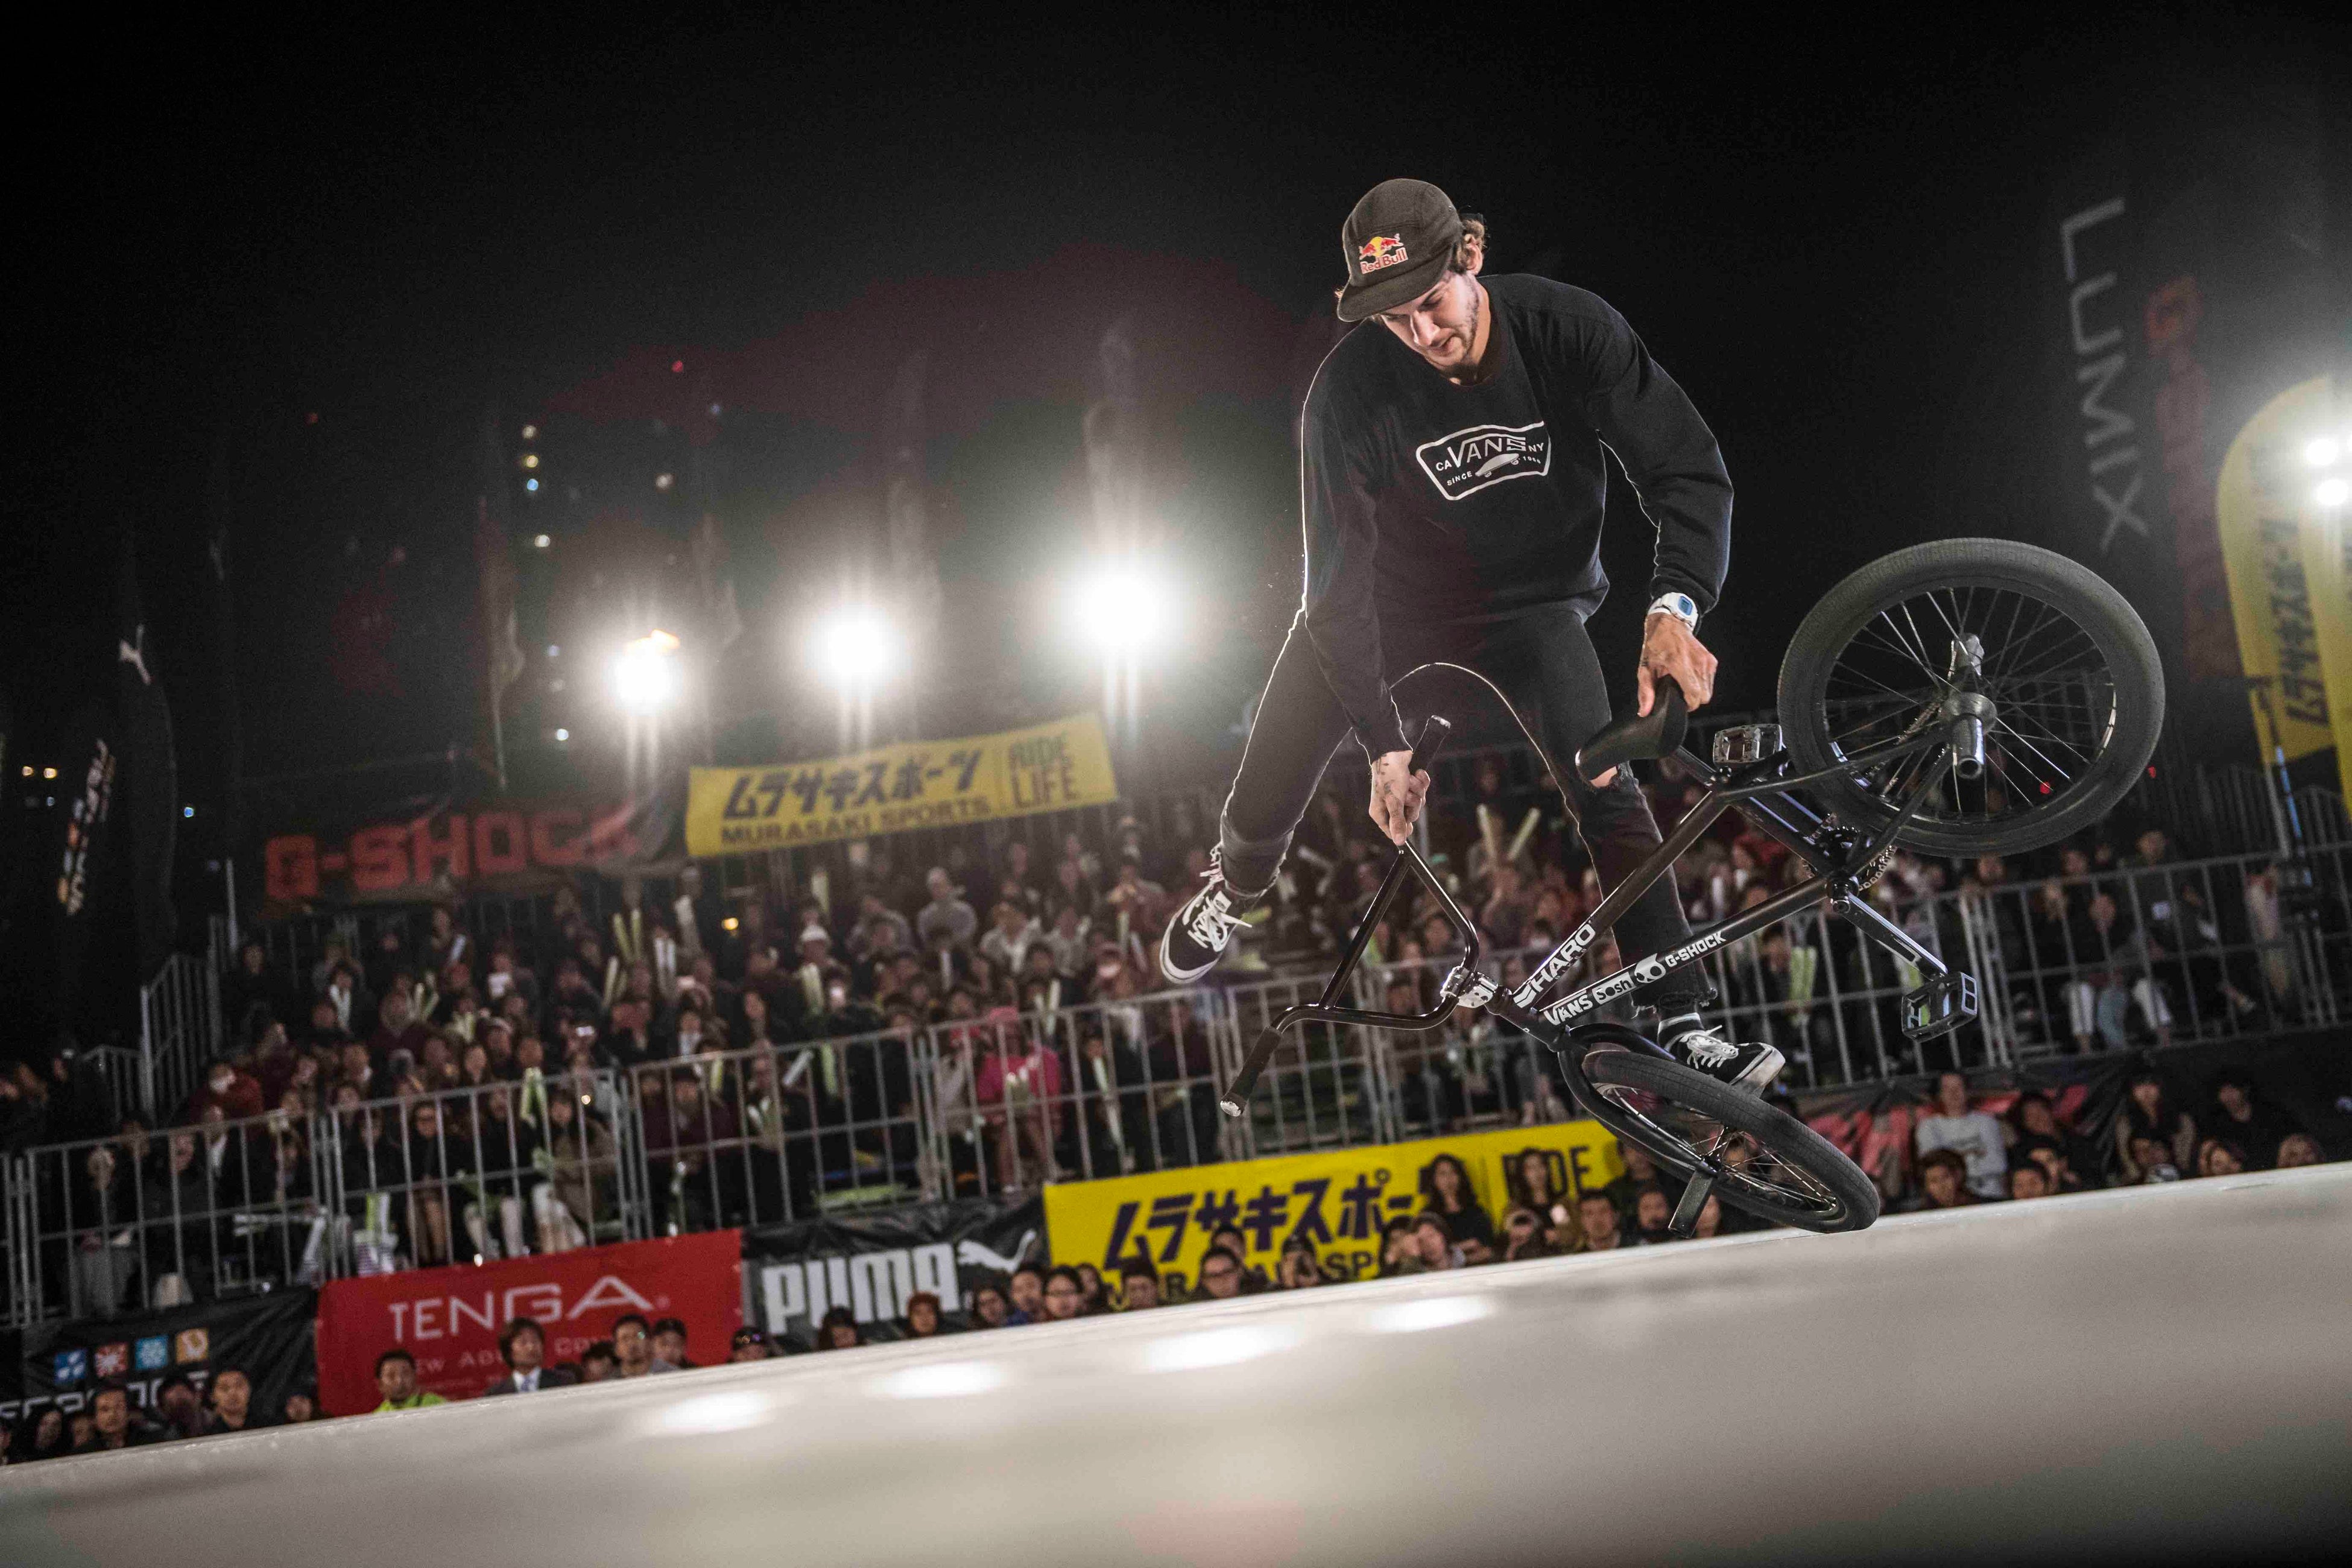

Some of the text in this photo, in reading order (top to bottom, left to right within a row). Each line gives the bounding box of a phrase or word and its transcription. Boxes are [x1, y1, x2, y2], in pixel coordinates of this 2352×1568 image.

[1361, 248, 1408, 273] Red Bull
[2062, 196, 2150, 553] LUMIX
[1436, 433, 1544, 472] CA VANS NY
[1447, 470, 1473, 486] SINCE
[724, 749, 984, 820] ムラサキスポーツ
[1011, 763, 1080, 808] LIFE
[1530, 923, 1596, 993] HARO
[1543, 990, 1593, 1025] VANS
[1664, 932, 1727, 968] G-SHOCK
[1104, 1168, 1432, 1271] ムラサキスポー
[388, 1274, 654, 1343] TENGA
[762, 1241, 960, 1335] PUMA
